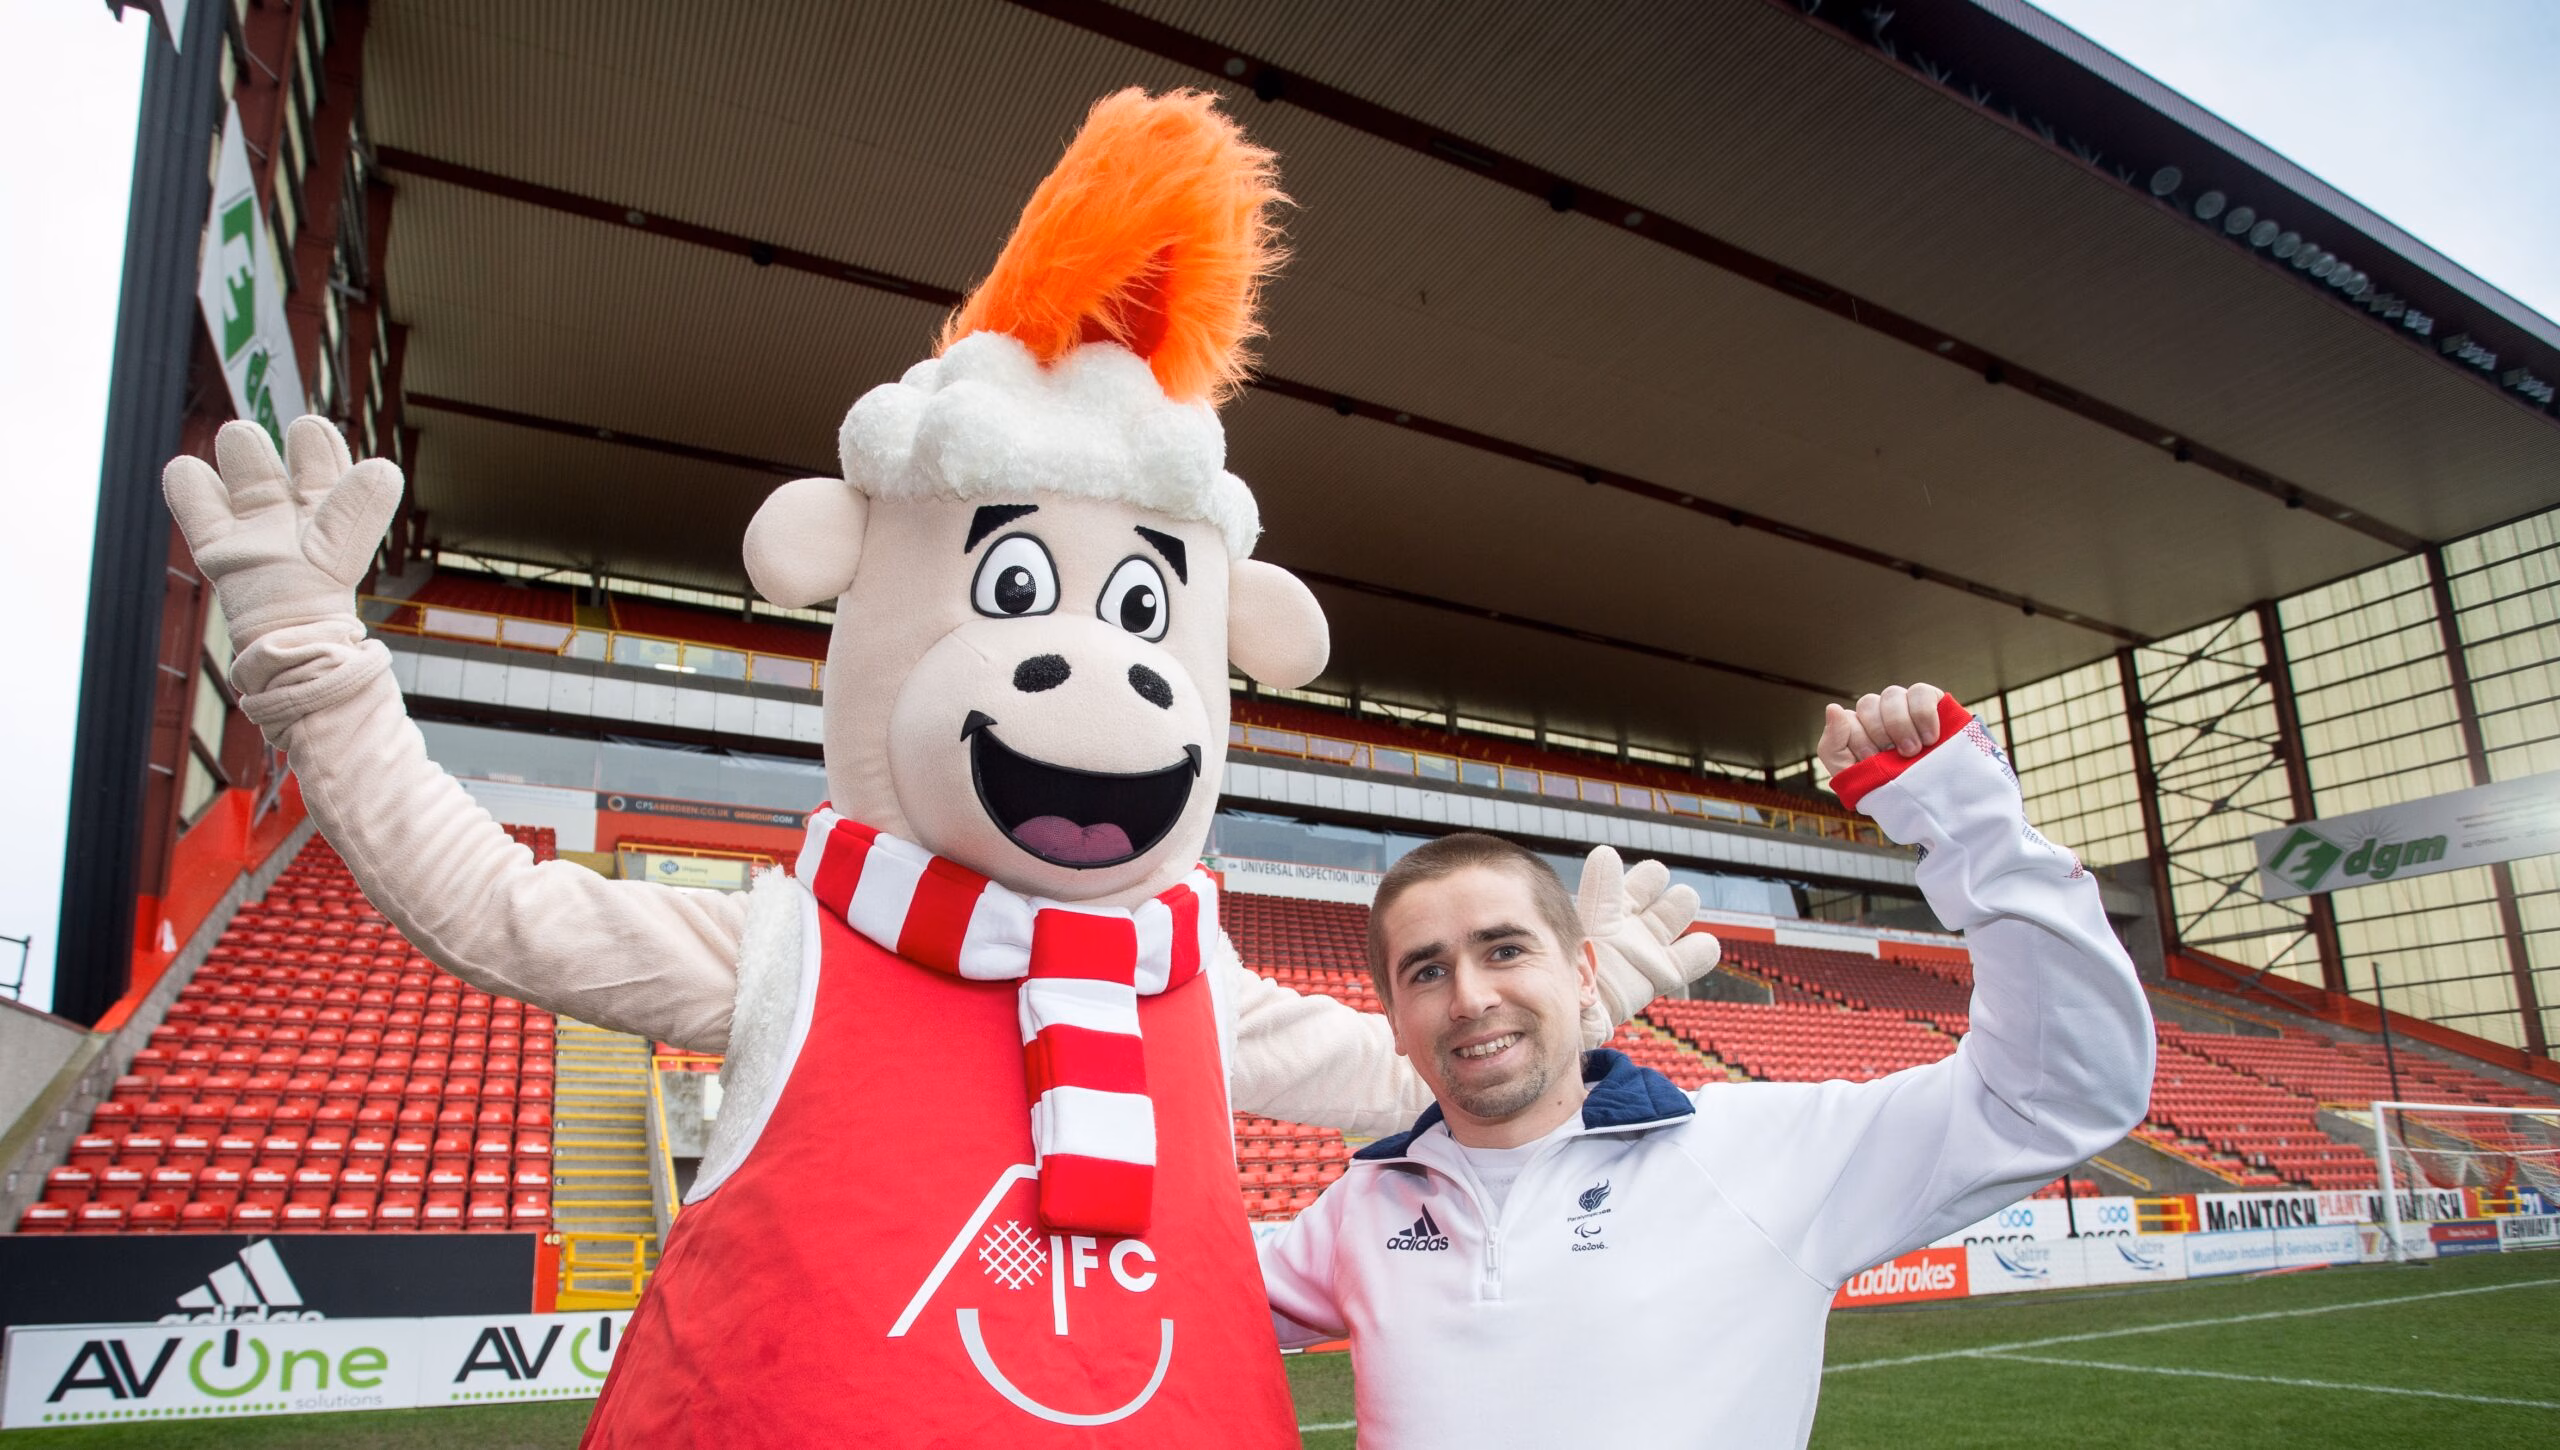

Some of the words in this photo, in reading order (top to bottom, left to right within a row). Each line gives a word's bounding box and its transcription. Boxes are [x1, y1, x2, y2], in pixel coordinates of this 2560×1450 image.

[2343, 835, 2448, 879] dgm
[1241, 860, 1294, 878] UNIVERSAL
[1296, 866, 1350, 884] INSPECTION
[1351, 871, 1370, 887] (UK)
[1371, 874, 1382, 887] LT
[2319, 1193, 2363, 1217] PLANT
[1386, 1235, 1449, 1251] adidas
[1846, 1257, 1957, 1297] Ladbrokes
[295, 1393, 383, 1411] solutions
